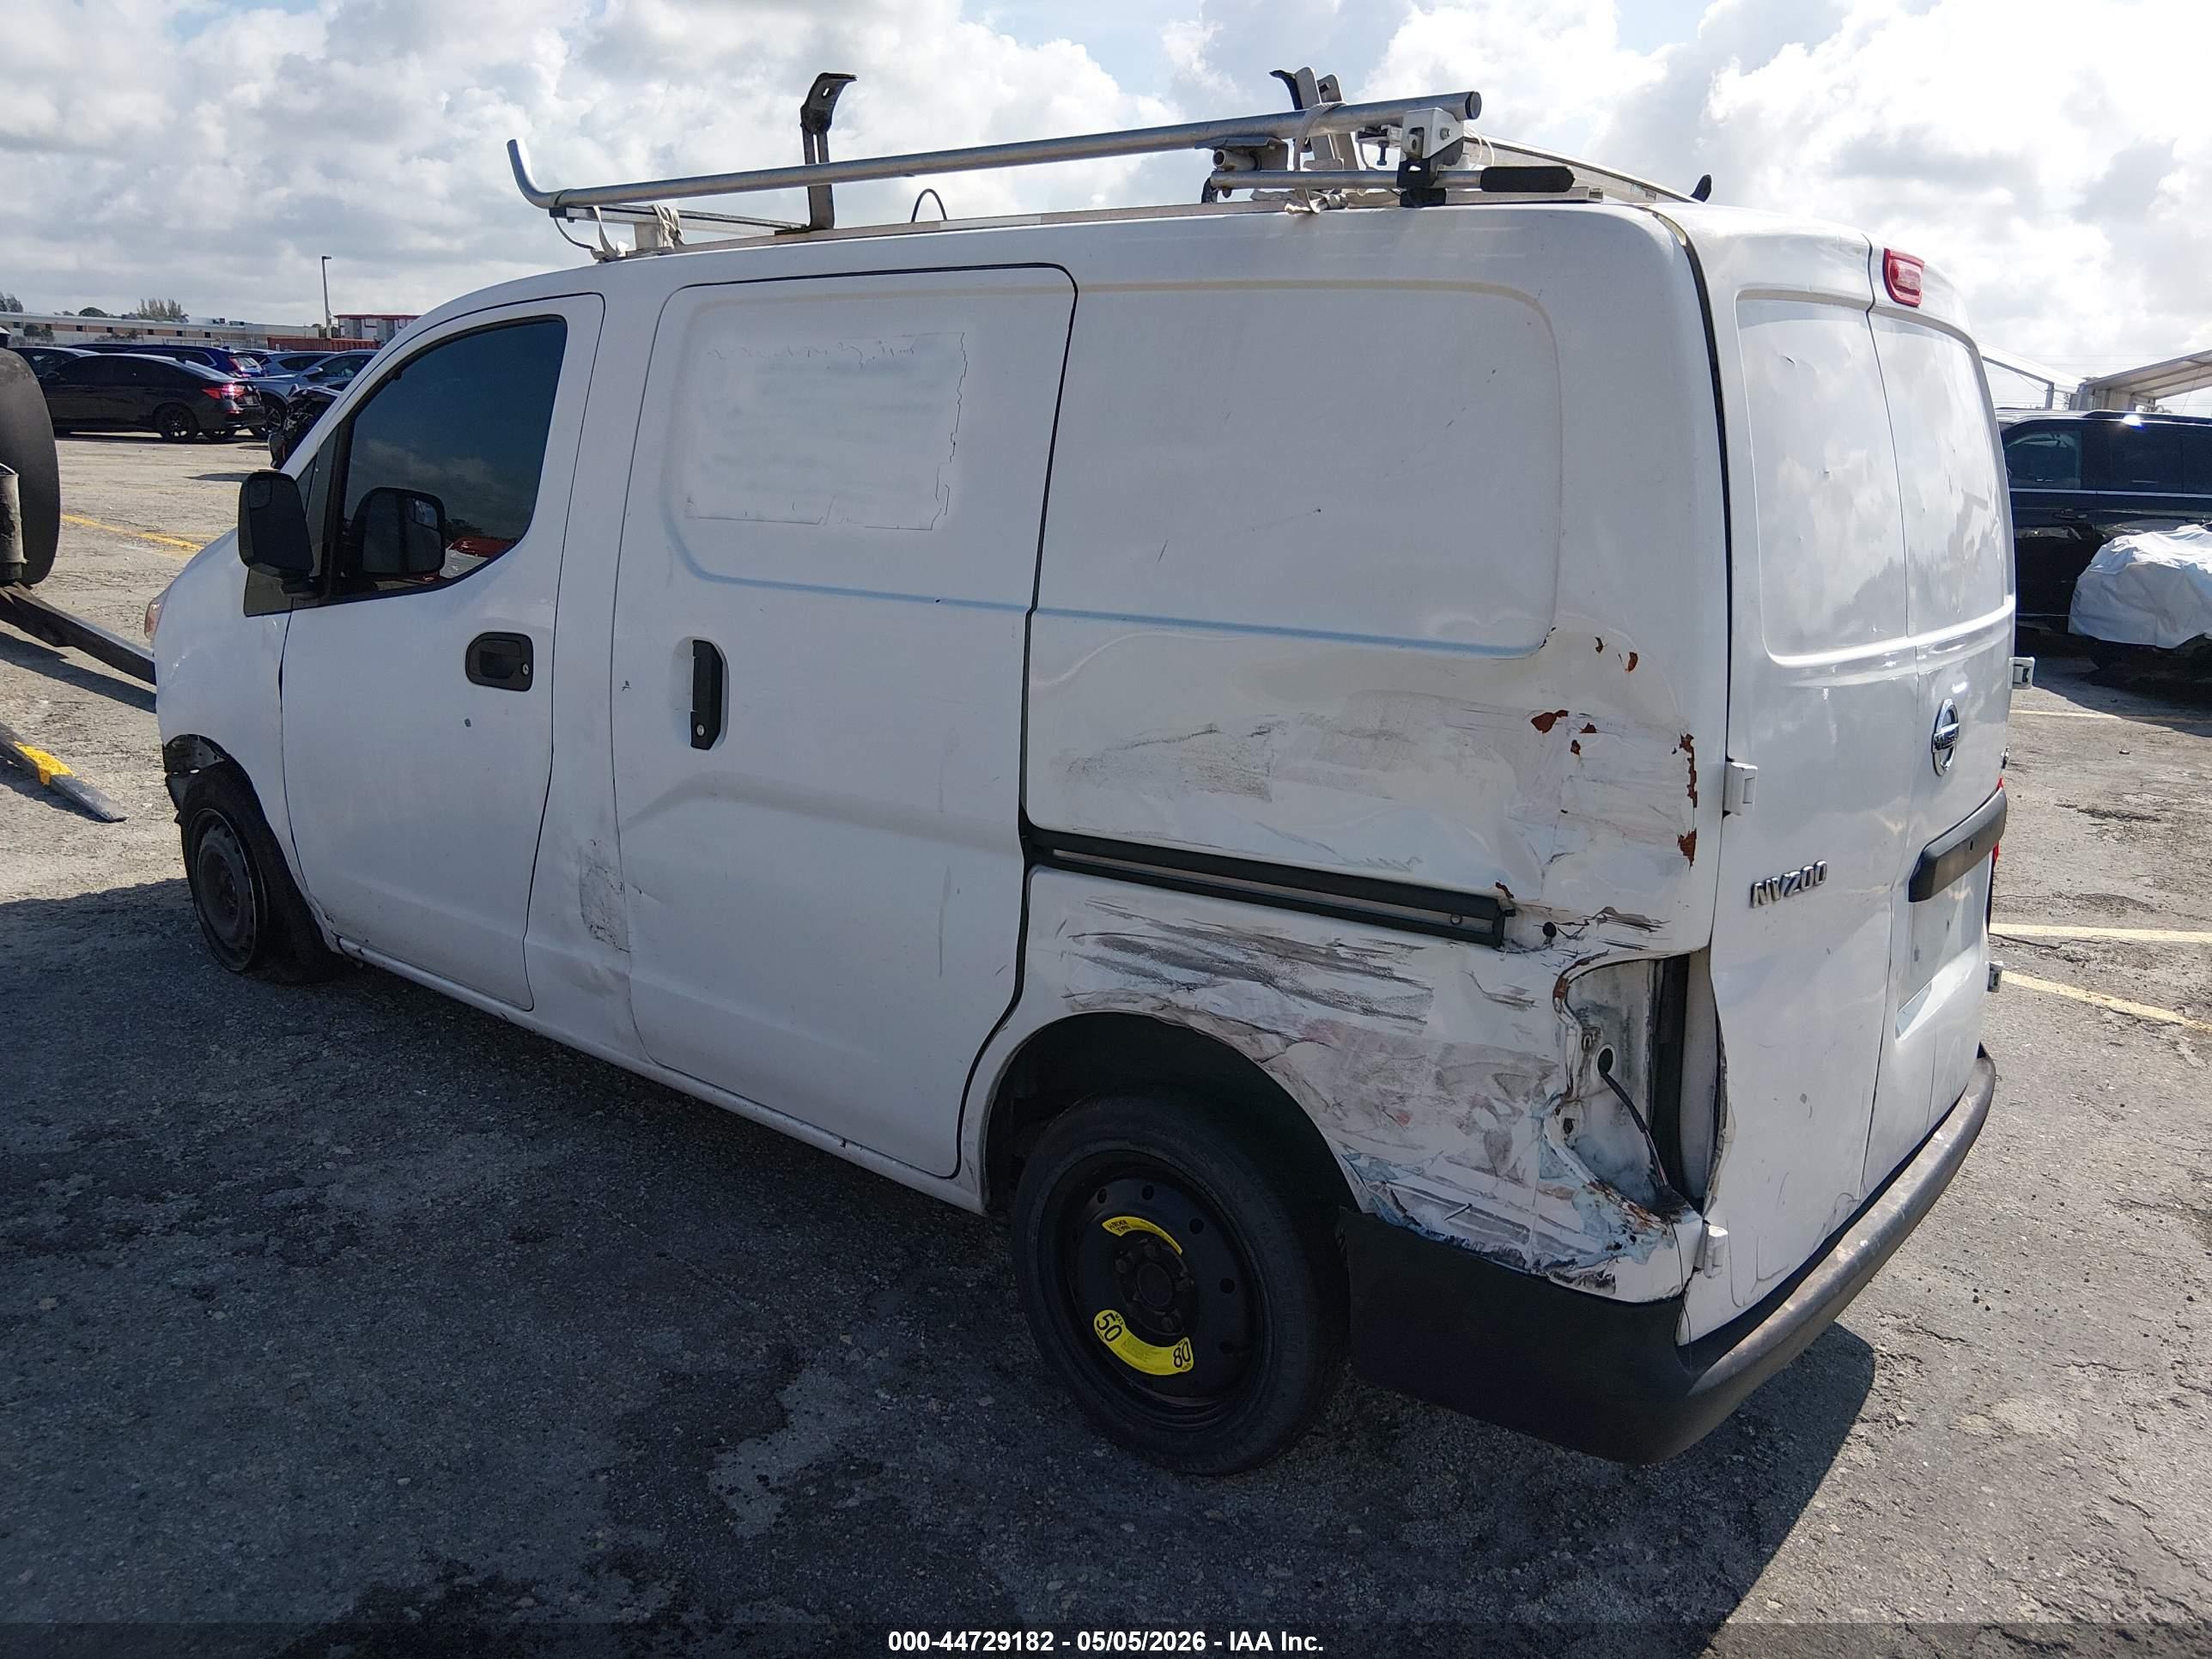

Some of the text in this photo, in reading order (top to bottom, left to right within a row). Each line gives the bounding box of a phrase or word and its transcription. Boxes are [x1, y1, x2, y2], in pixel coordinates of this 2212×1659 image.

[1751, 860, 1827, 908] NV200
[1097, 1313, 1122, 1342] 50
[1173, 1341, 1191, 1369] 80
